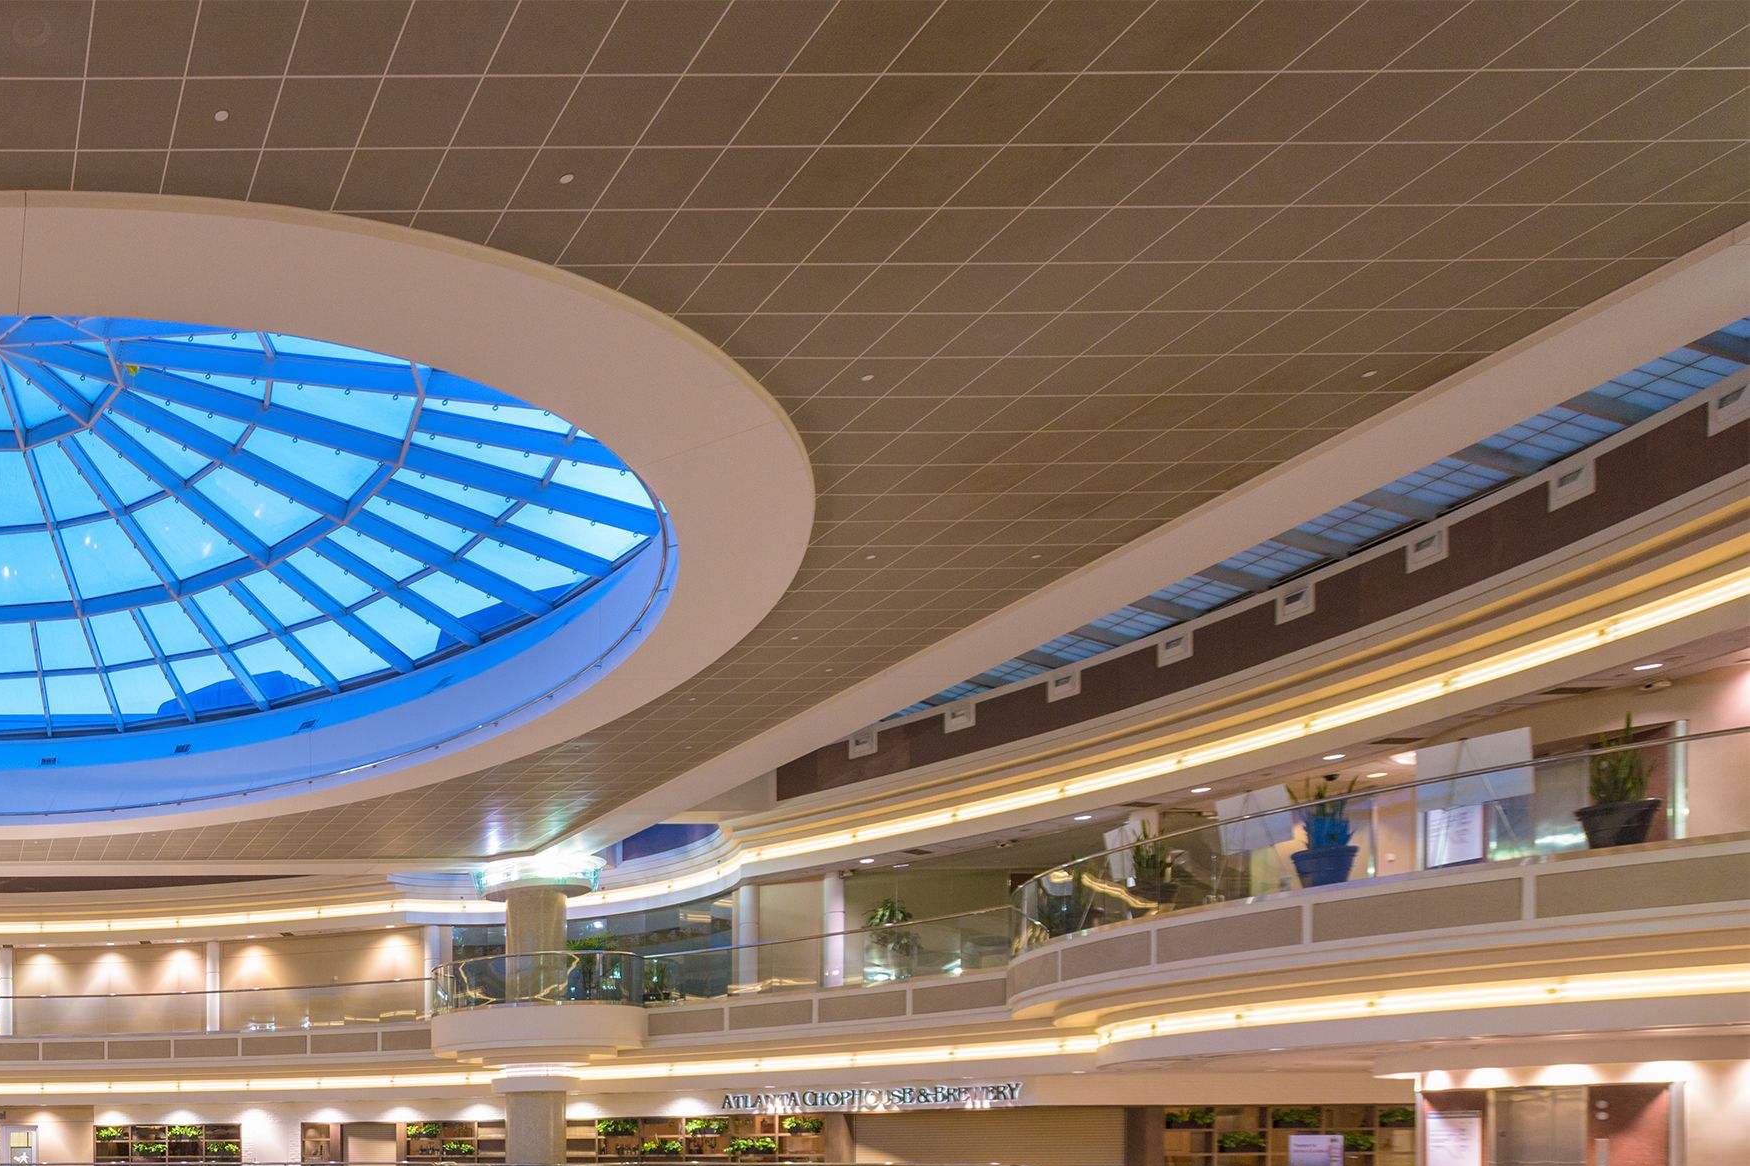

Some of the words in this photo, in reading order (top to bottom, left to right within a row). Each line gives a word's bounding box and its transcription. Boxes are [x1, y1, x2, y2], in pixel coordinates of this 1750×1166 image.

[722, 1091, 800, 1110] ATLANTA
[916, 1089, 933, 1105] &
[934, 1082, 1022, 1103] BREWERY
